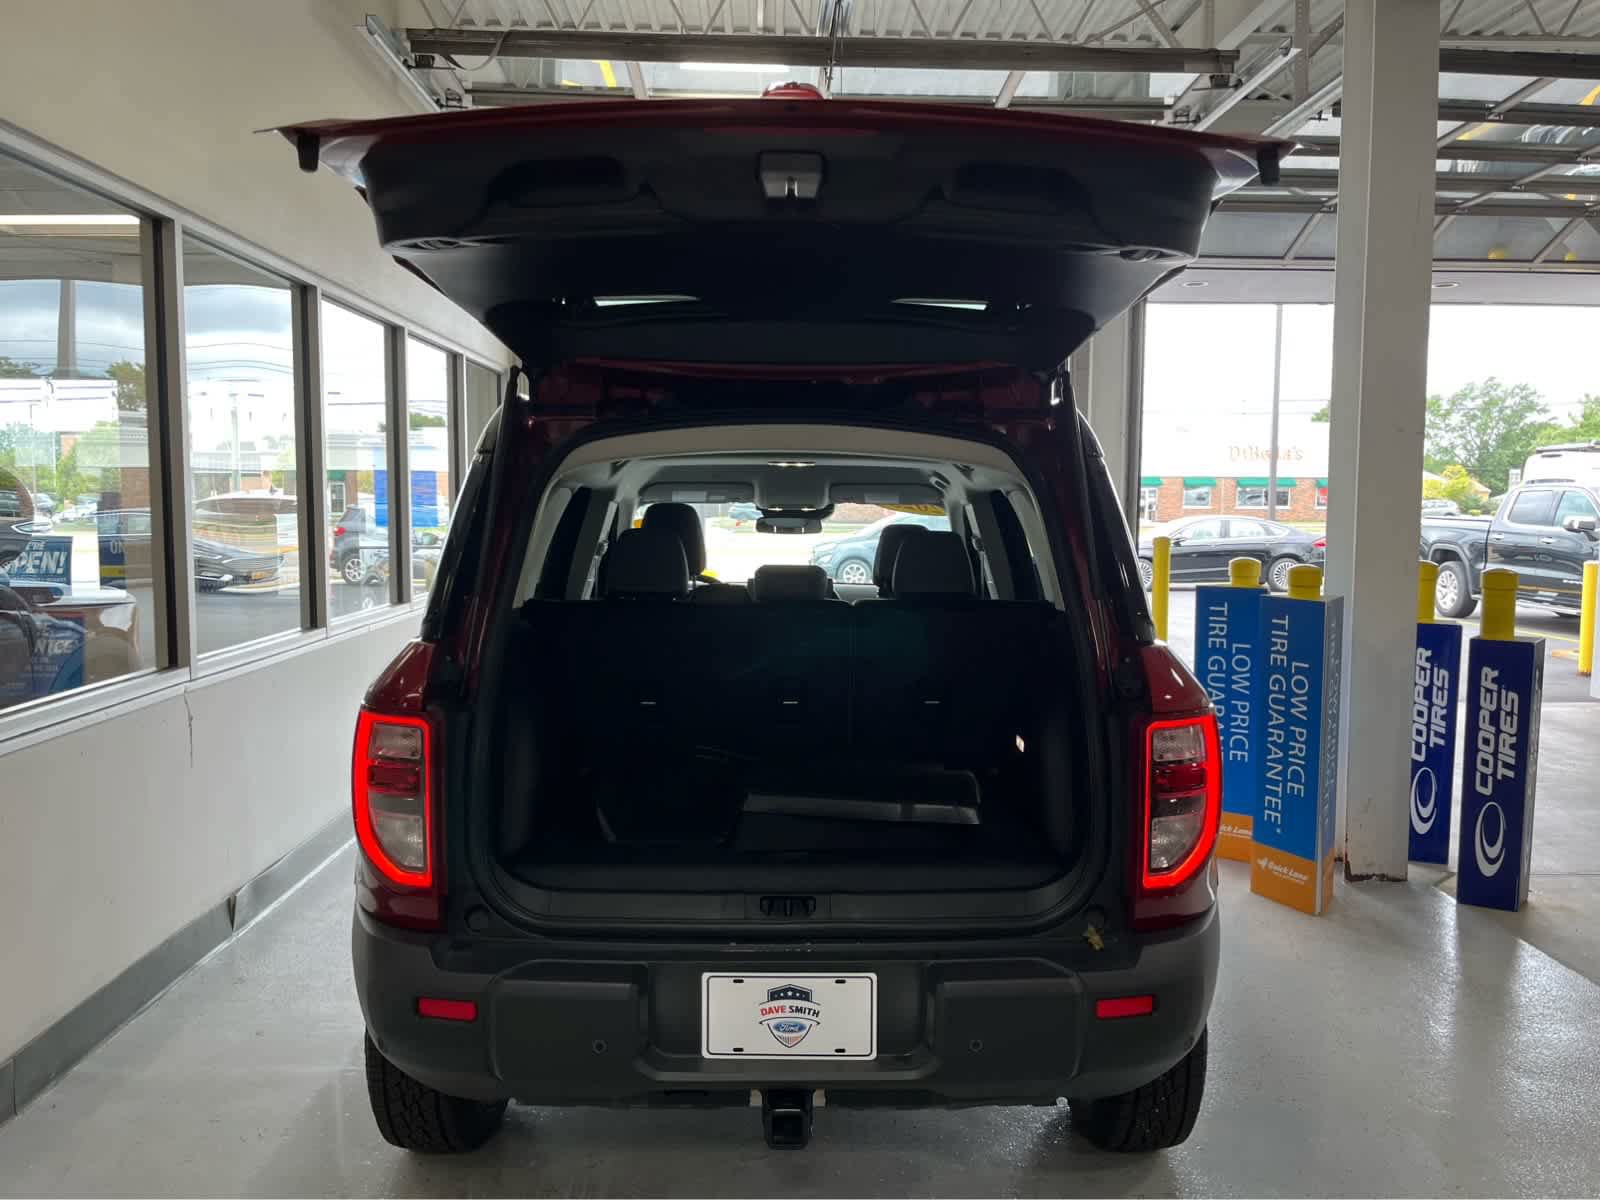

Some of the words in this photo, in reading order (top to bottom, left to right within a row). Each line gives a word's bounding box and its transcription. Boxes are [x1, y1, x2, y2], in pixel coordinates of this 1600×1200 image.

[1208, 602, 1228, 649] TIRE
[1270, 615, 1289, 667] TIRE
[1231, 643, 1251, 695] LOW
[1289, 661, 1310, 720] LOW
[1229, 700, 1249, 763] PRICE
[1411, 647, 1432, 762] COOPER
[1429, 668, 1449, 748] TIRES
[1475, 666, 1499, 796] COOPER
[1496, 687, 1519, 780] TIRES
[1287, 726, 1307, 798] PRICE
[760, 1005, 786, 1017] DAVE
[788, 1005, 820, 1018] SMITH
[778, 1022, 801, 1033] Ford
